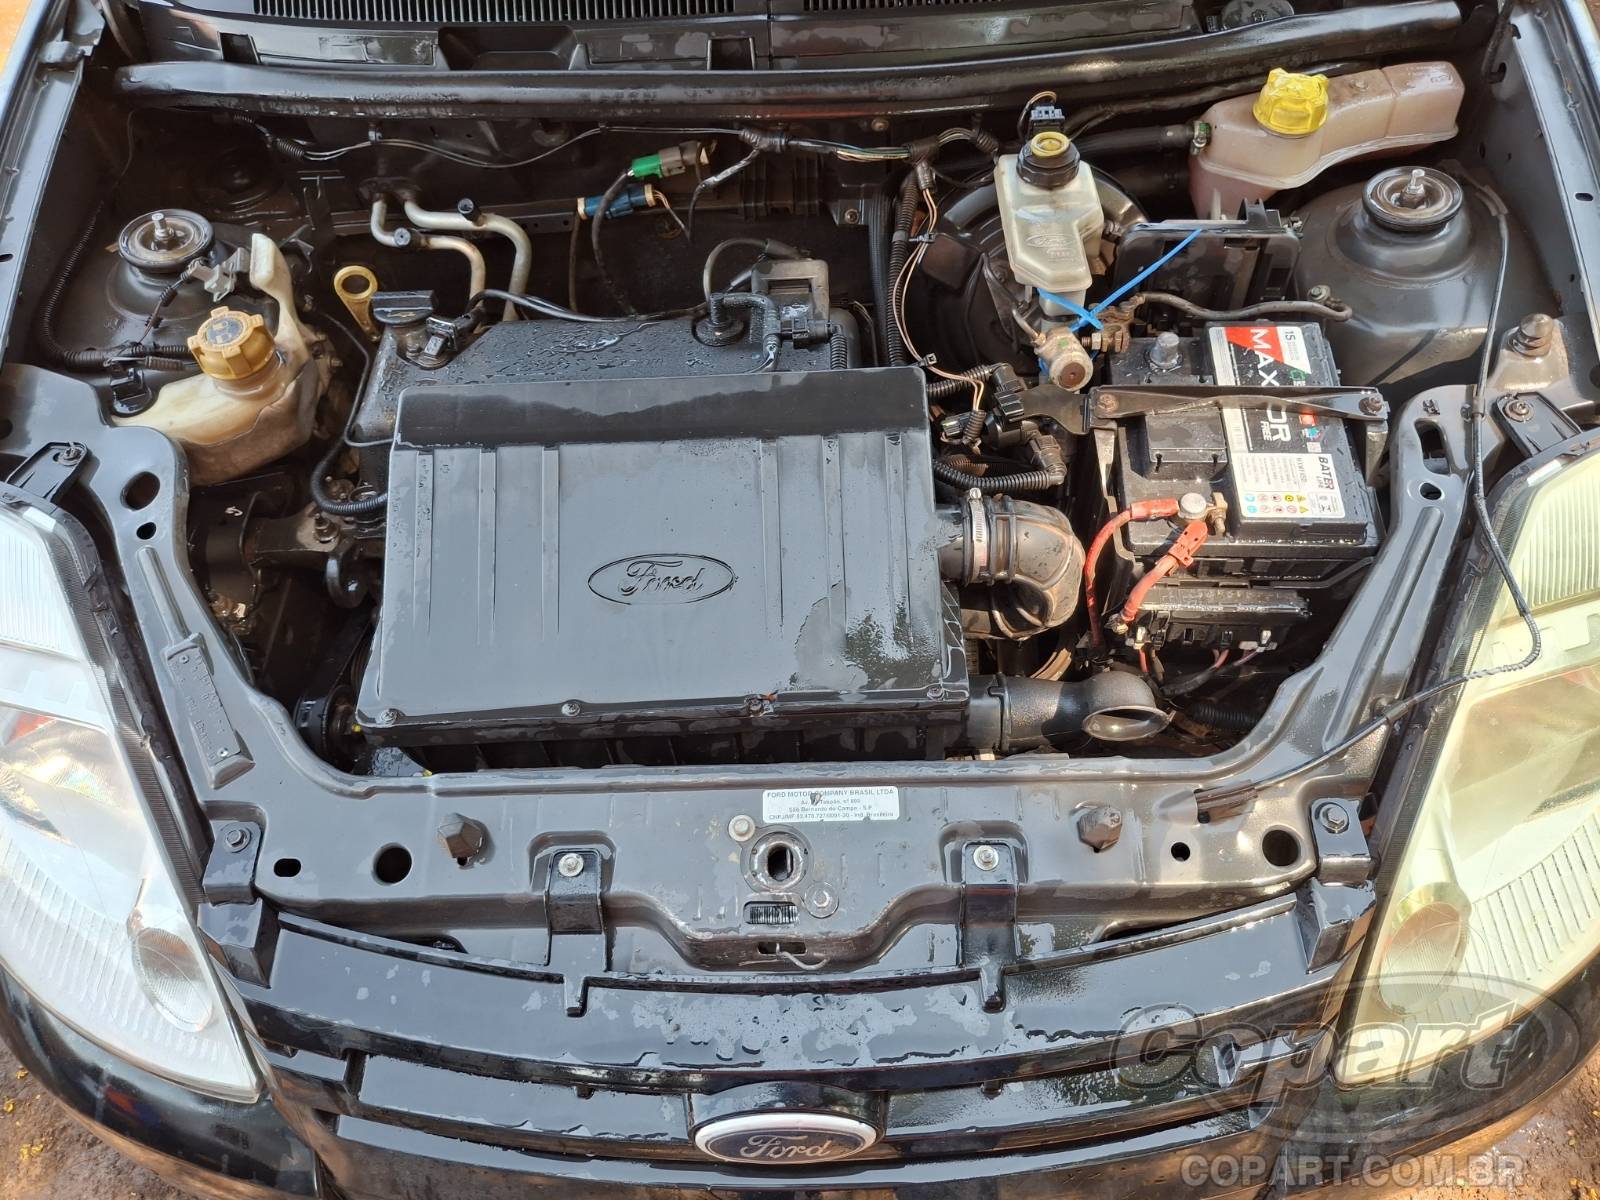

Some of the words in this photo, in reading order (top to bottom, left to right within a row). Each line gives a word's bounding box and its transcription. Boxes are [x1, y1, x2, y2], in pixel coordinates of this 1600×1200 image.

[1260, 420, 1272, 441] FREE
[619, 560, 706, 597] Ford
[740, 1134, 832, 1160] Ford
